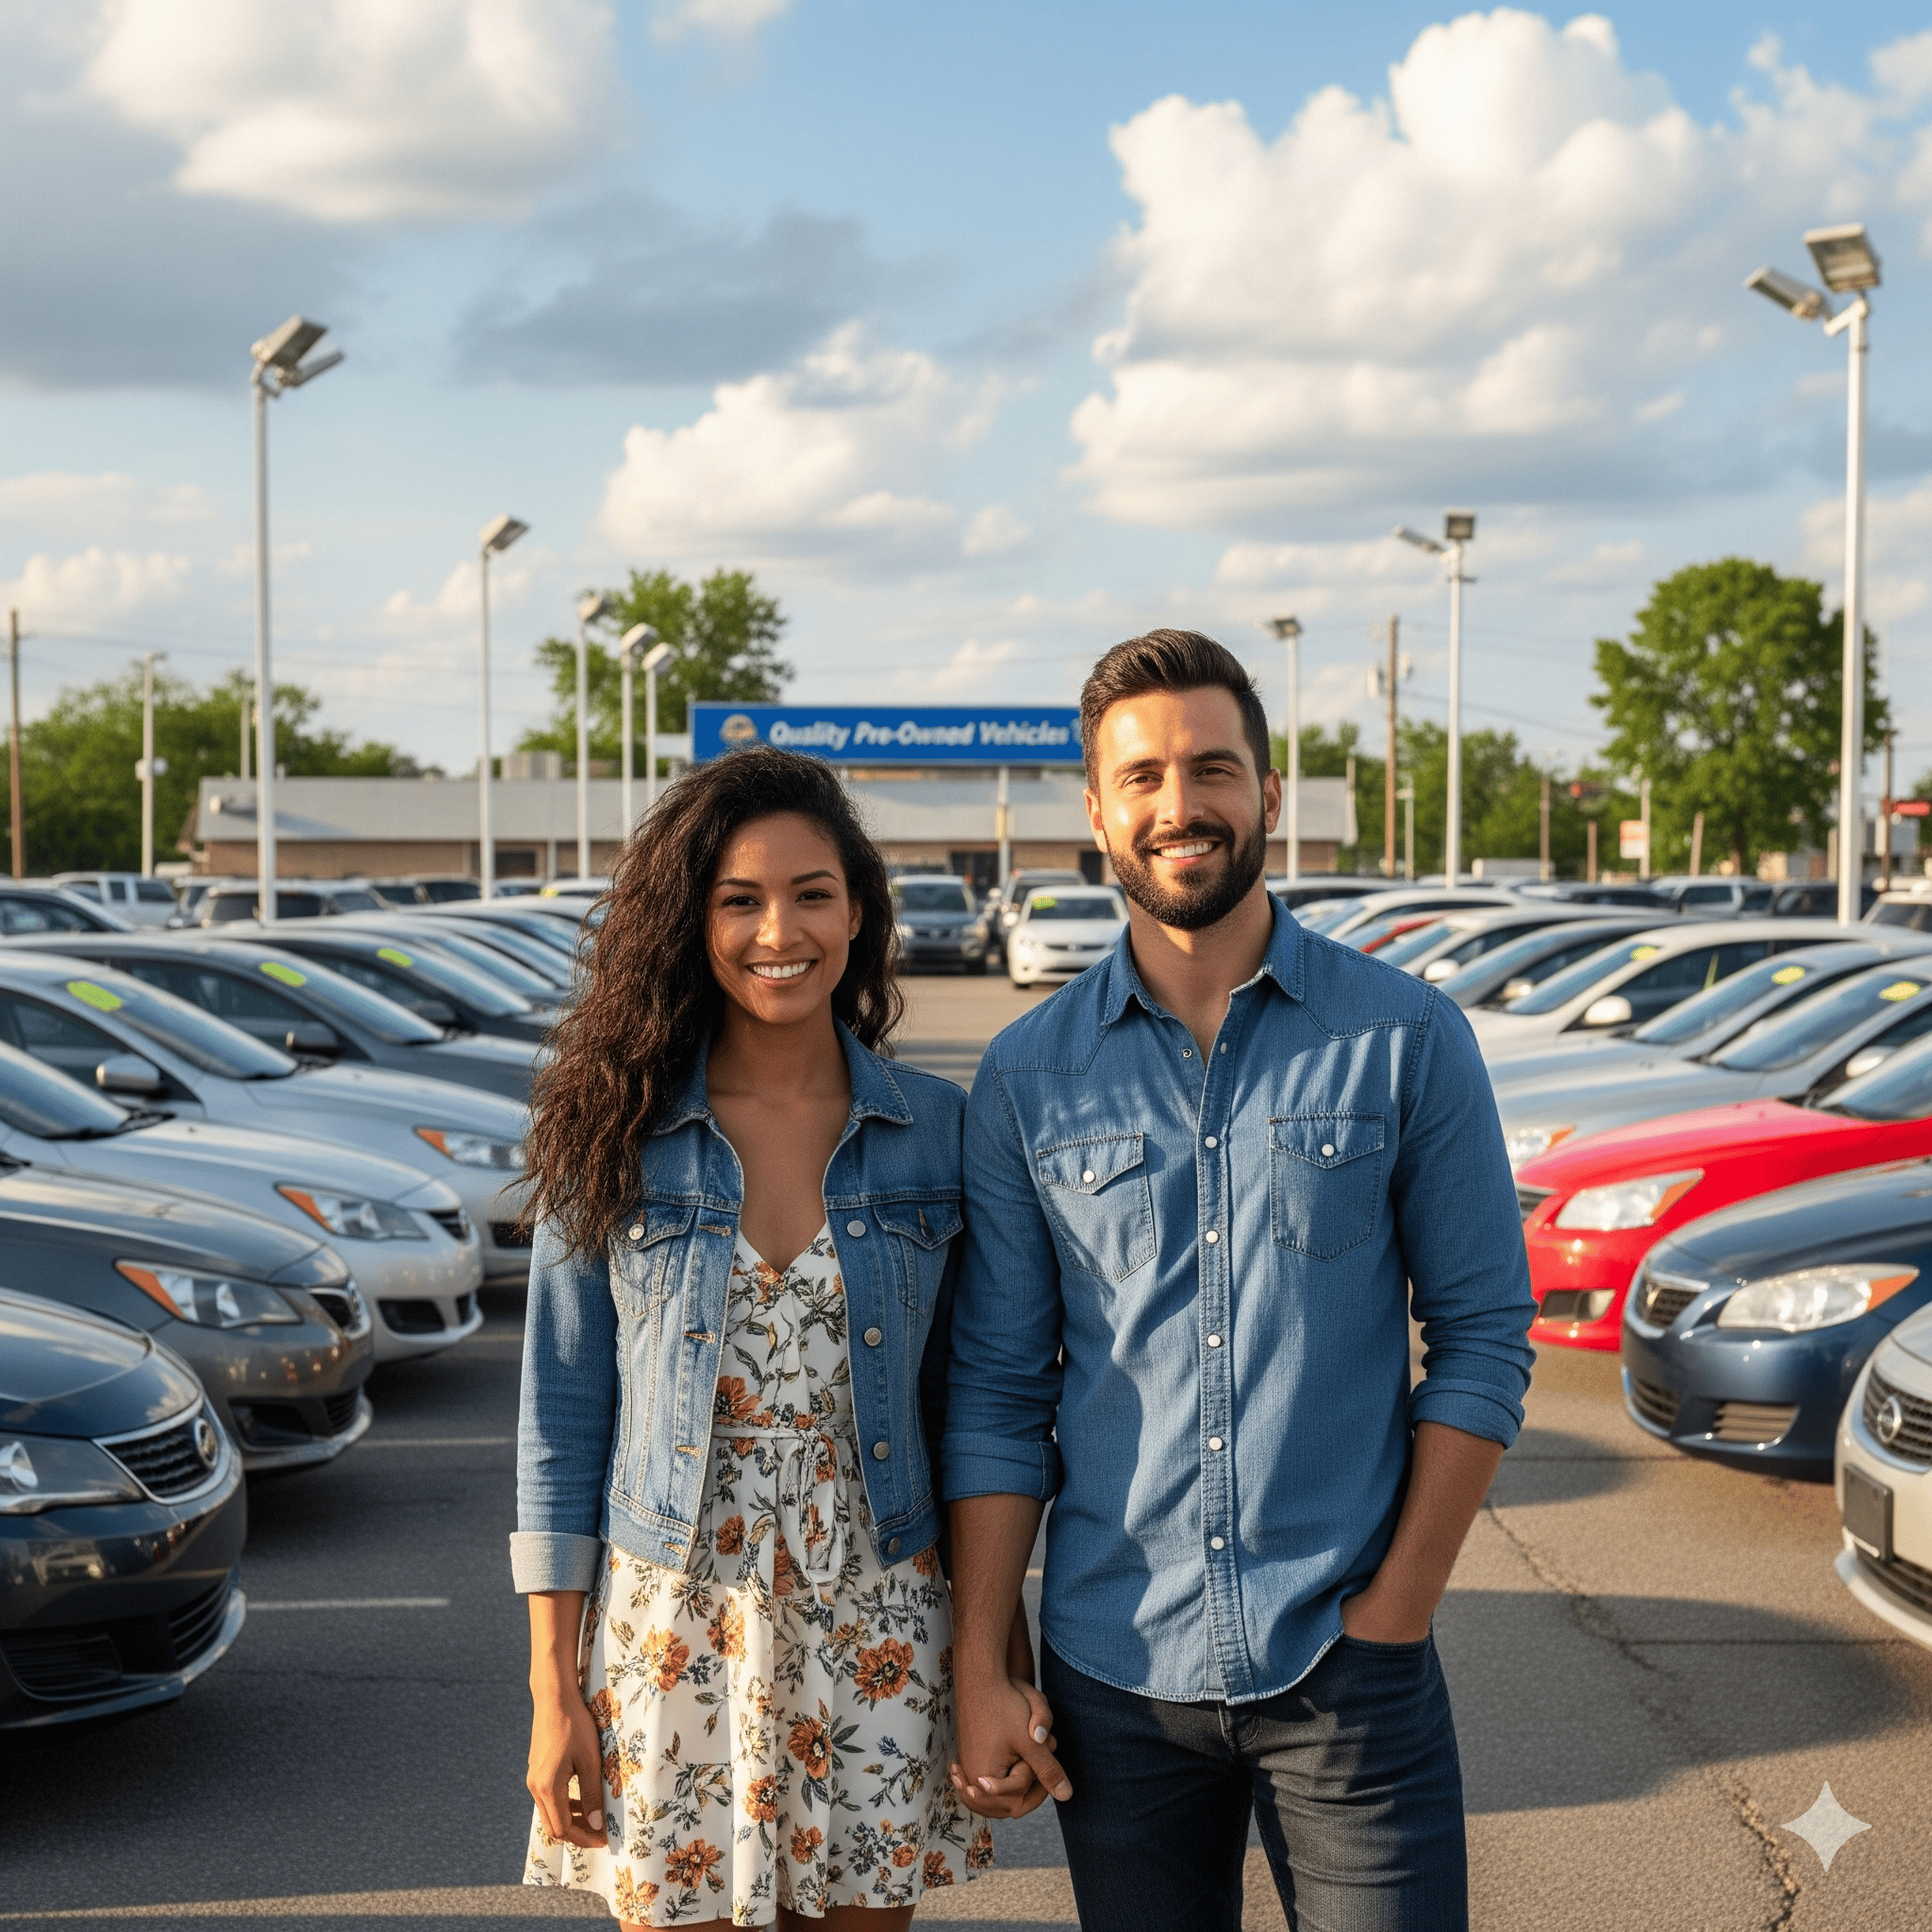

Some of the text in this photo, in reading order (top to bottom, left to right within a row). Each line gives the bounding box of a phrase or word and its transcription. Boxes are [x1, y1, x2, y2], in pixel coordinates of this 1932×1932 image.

[769, 720, 1068, 751] Quality Pre-Owned Vehicles
